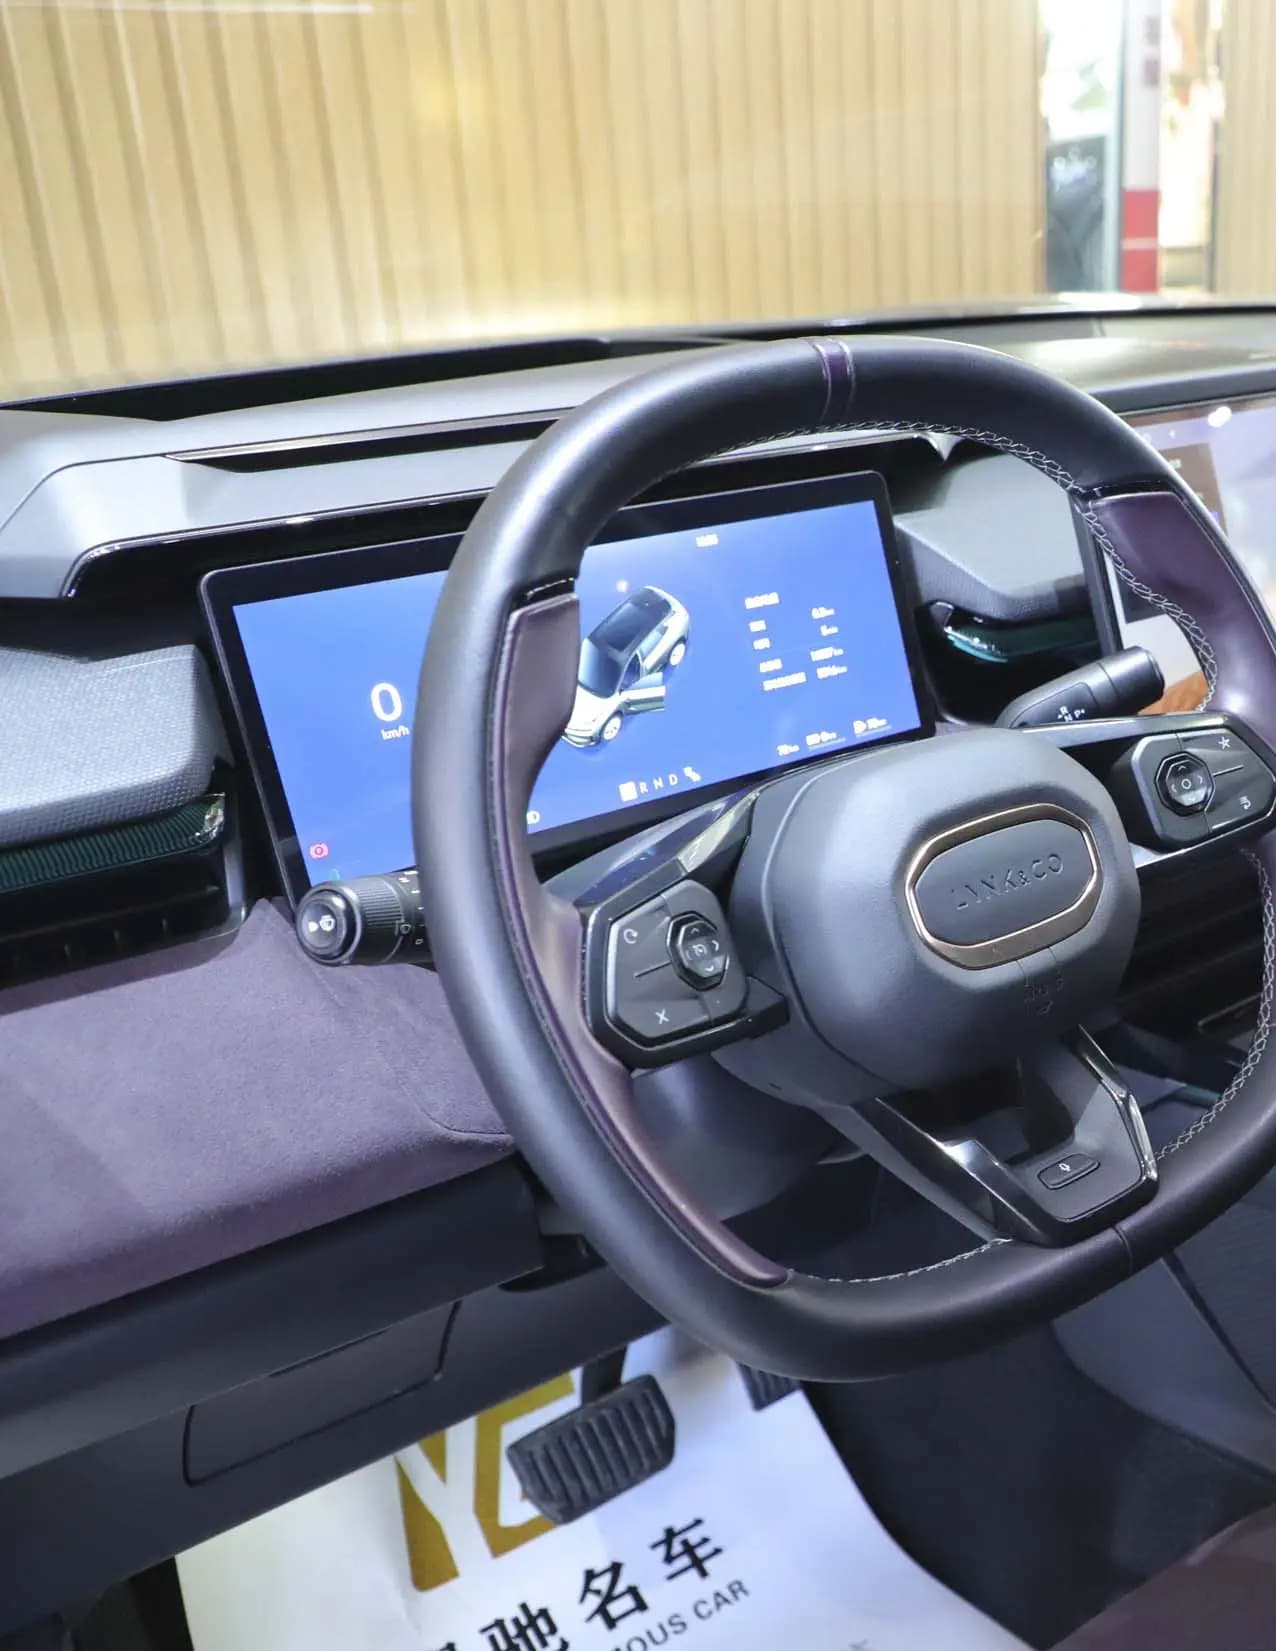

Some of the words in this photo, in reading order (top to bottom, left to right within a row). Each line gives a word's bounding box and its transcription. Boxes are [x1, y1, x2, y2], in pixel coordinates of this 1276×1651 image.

[370, 682, 404, 722] 0
[381, 724, 411, 741] km/h
[639, 782, 649, 794] R
[653, 776, 664, 790] N
[668, 773, 679, 786] D
[437, 1518, 724, 1651] 驰名车
[612, 1613, 688, 1651] OUS
[693, 1579, 750, 1620] CAR
